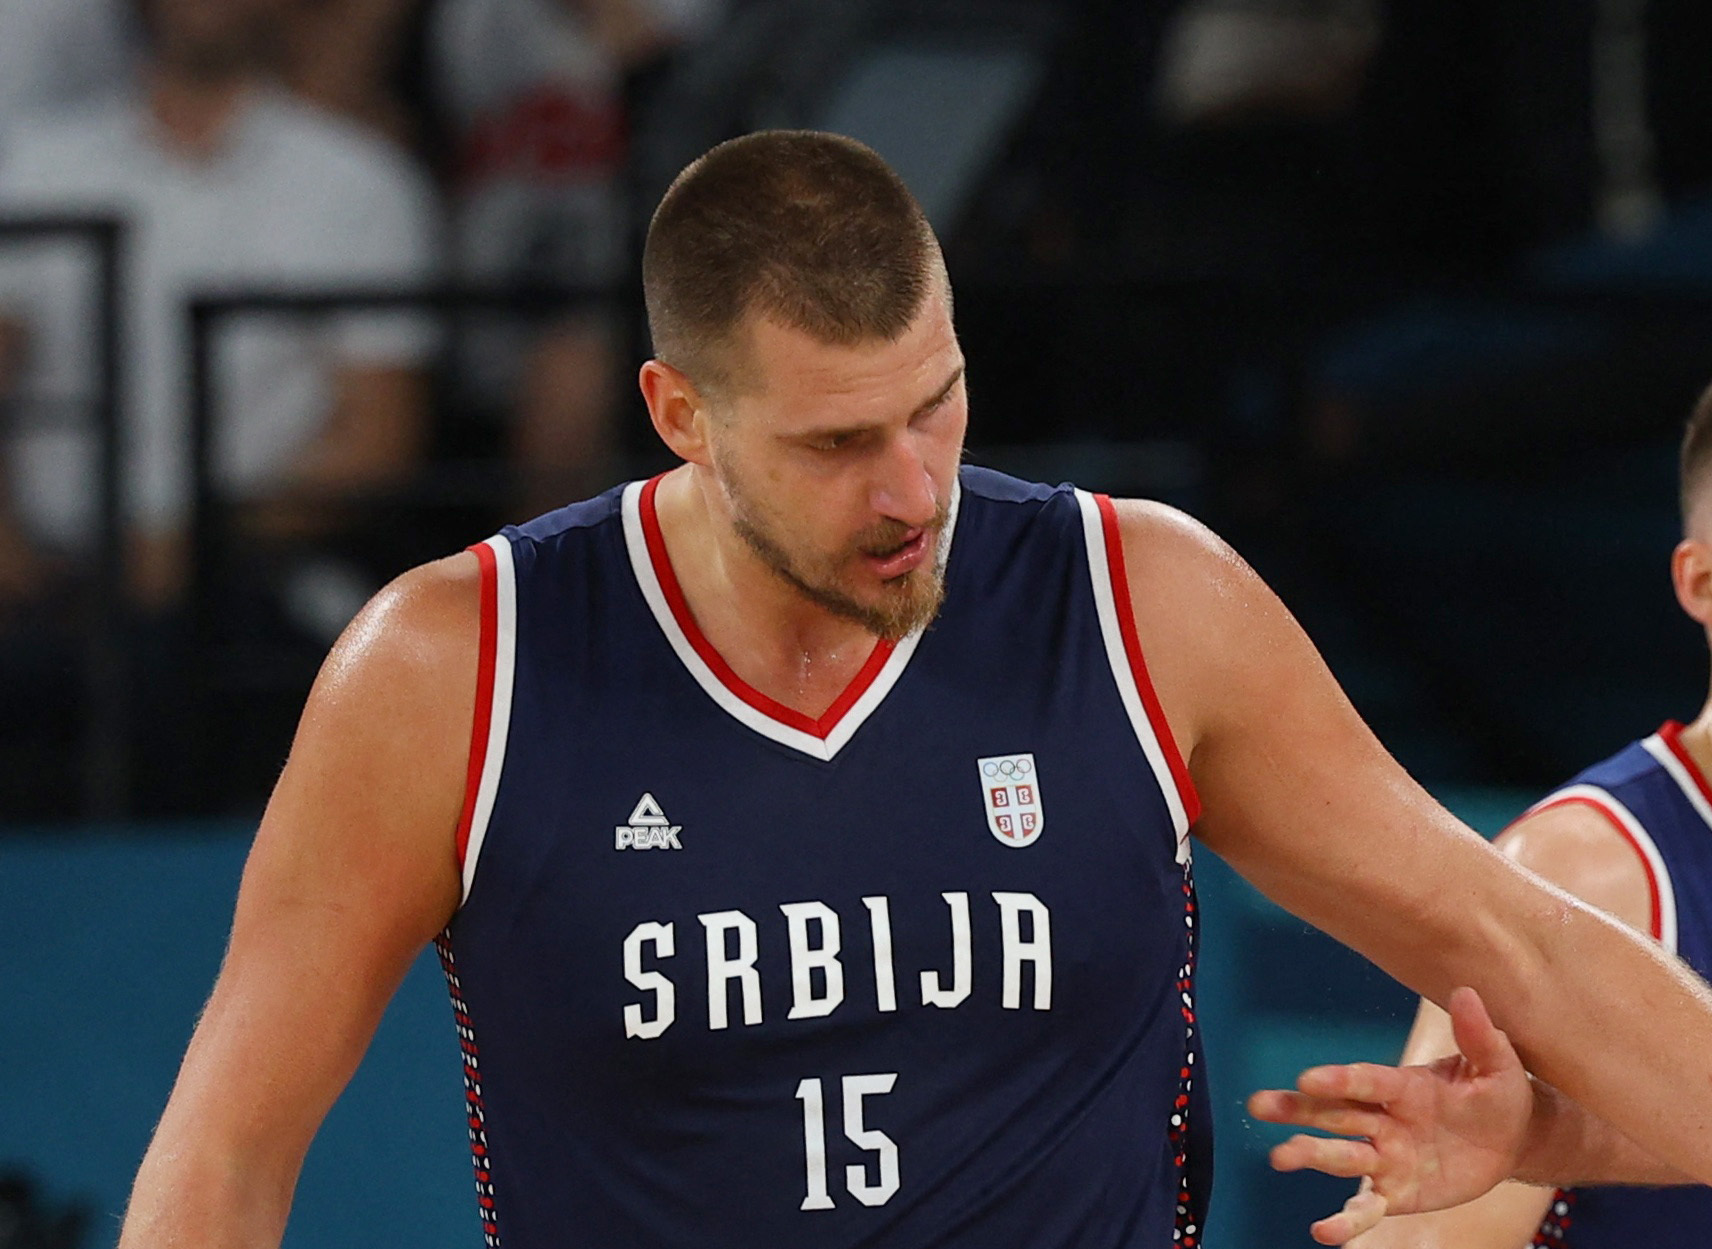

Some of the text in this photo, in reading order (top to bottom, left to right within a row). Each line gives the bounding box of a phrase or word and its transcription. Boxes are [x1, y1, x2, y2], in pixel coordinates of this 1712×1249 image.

[615, 826, 683, 850] PEAK
[623, 891, 1053, 1040] SRBIJA
[795, 1073, 900, 1211] 15
